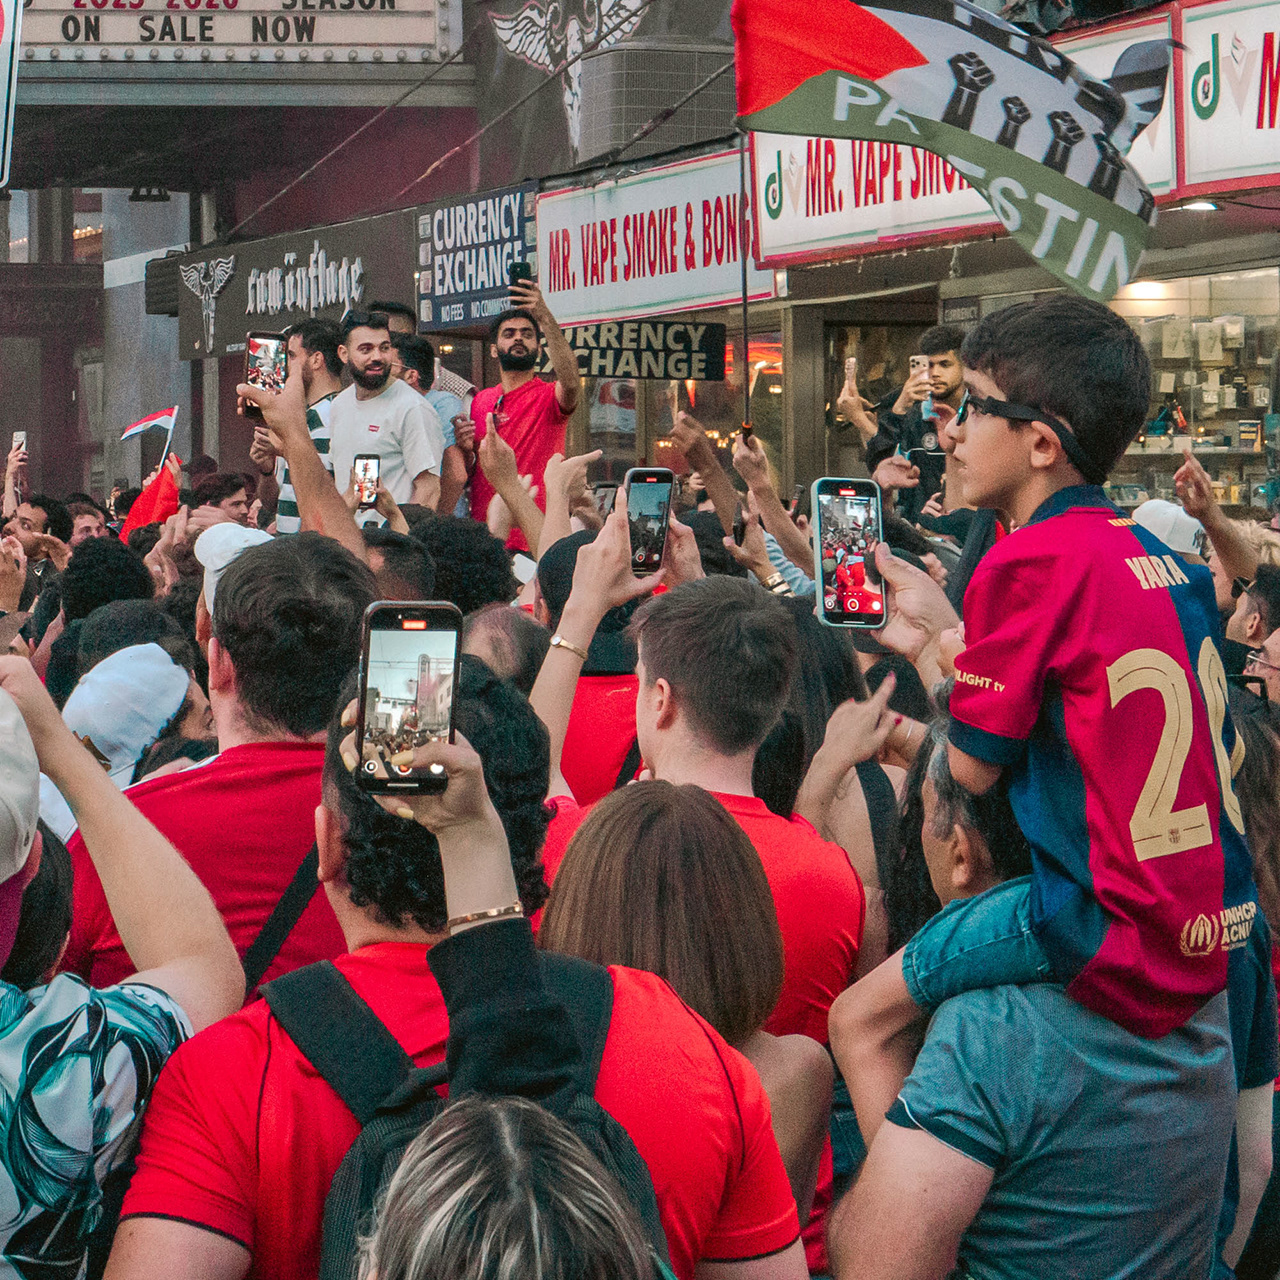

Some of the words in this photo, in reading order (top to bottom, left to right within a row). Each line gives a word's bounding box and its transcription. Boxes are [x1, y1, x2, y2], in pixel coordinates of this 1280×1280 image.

[61, 14, 100, 42] ON
[139, 14, 214, 42] SALE
[252, 15, 317, 42] NOW
[806, 137, 843, 218] MR.
[852, 139, 903, 209] VAPE
[433, 192, 521, 252] CURRENCY
[549, 228, 576, 294] MR.
[581, 218, 618, 288] VAPE
[623, 206, 678, 282] SMOKE
[684, 202, 697, 272] &
[702, 191, 753, 268] BONG
[442, 306, 450, 323] NO
[451, 303, 464, 322] FEES
[471, 301, 480, 318] NO
[1124, 554, 1190, 590] YARA
[994, 681, 1005, 692] tv
